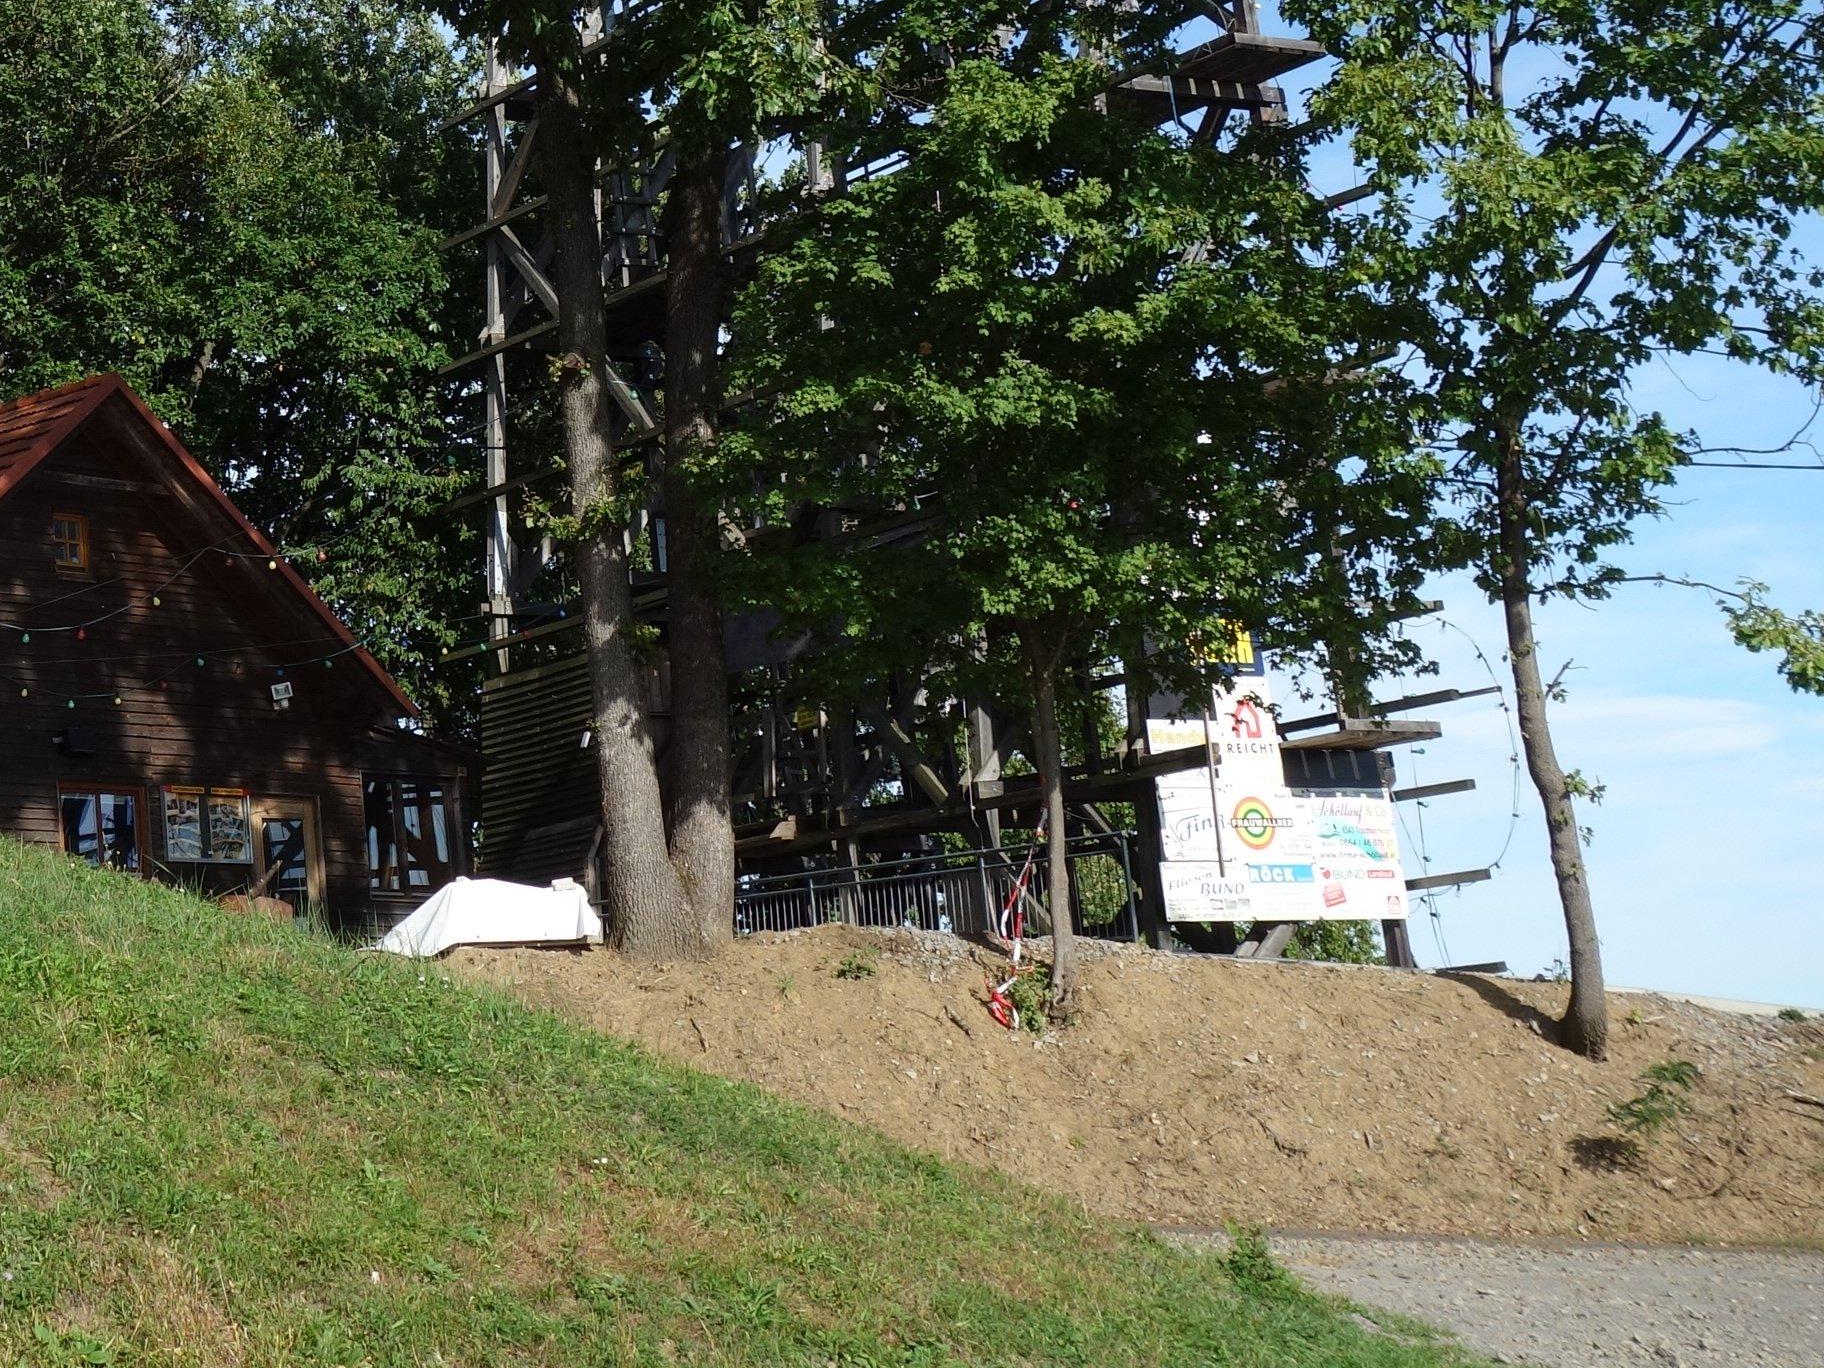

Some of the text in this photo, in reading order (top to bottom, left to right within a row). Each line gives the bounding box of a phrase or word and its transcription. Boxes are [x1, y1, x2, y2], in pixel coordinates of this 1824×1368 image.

[1227, 743, 1274, 755] REICHT
[1250, 865, 1296, 882] RÖCK
[1332, 869, 1365, 880] BUND
[1200, 882, 1245, 896] BUND
